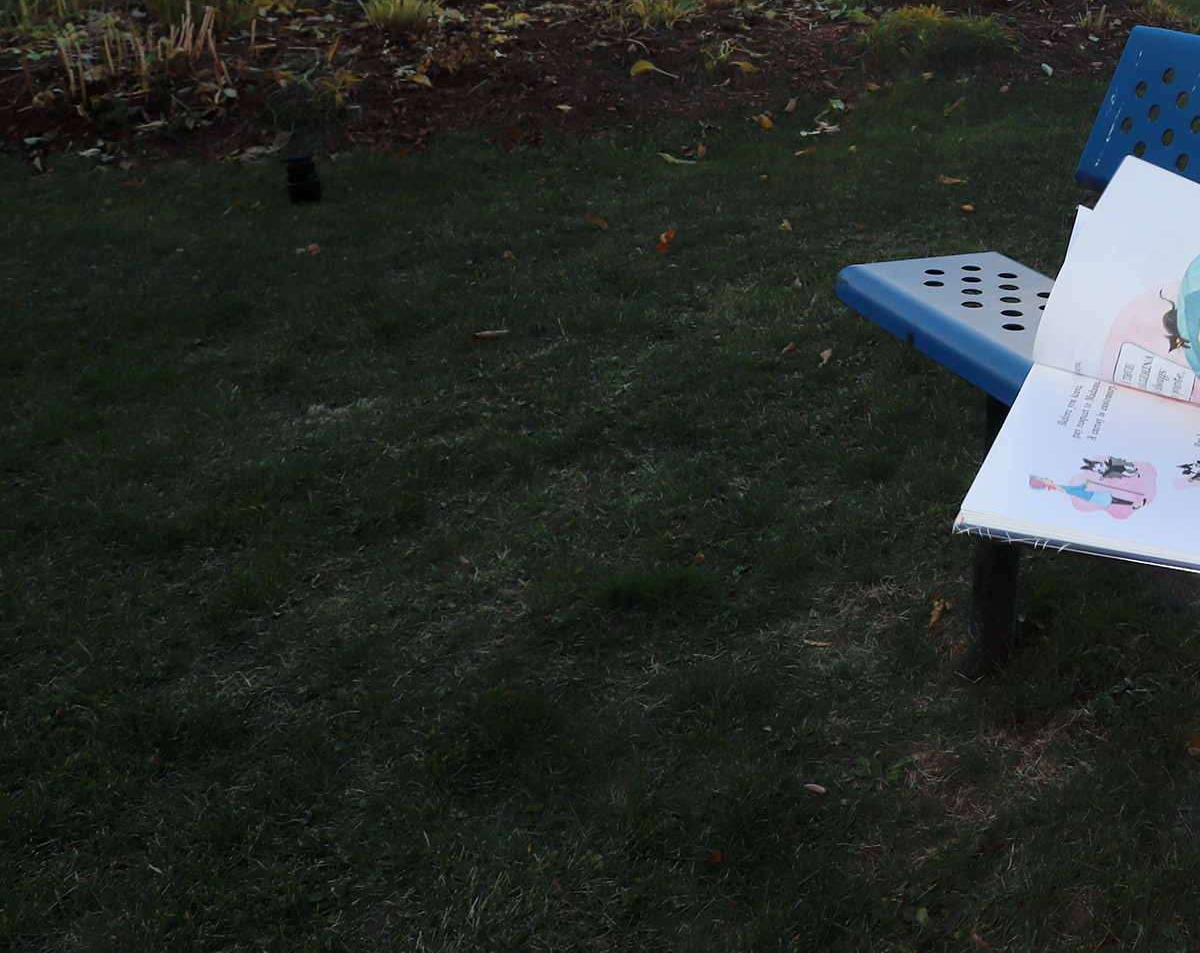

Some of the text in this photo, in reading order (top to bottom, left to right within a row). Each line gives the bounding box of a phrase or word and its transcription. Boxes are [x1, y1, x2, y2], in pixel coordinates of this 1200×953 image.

[1123, 362, 1134, 381] TRUE
[1057, 409, 1072, 426] Before
[1068, 399, 1076, 409] you
[1077, 409, 1089, 428] respect
[1072, 428, 1083, 439] pay
